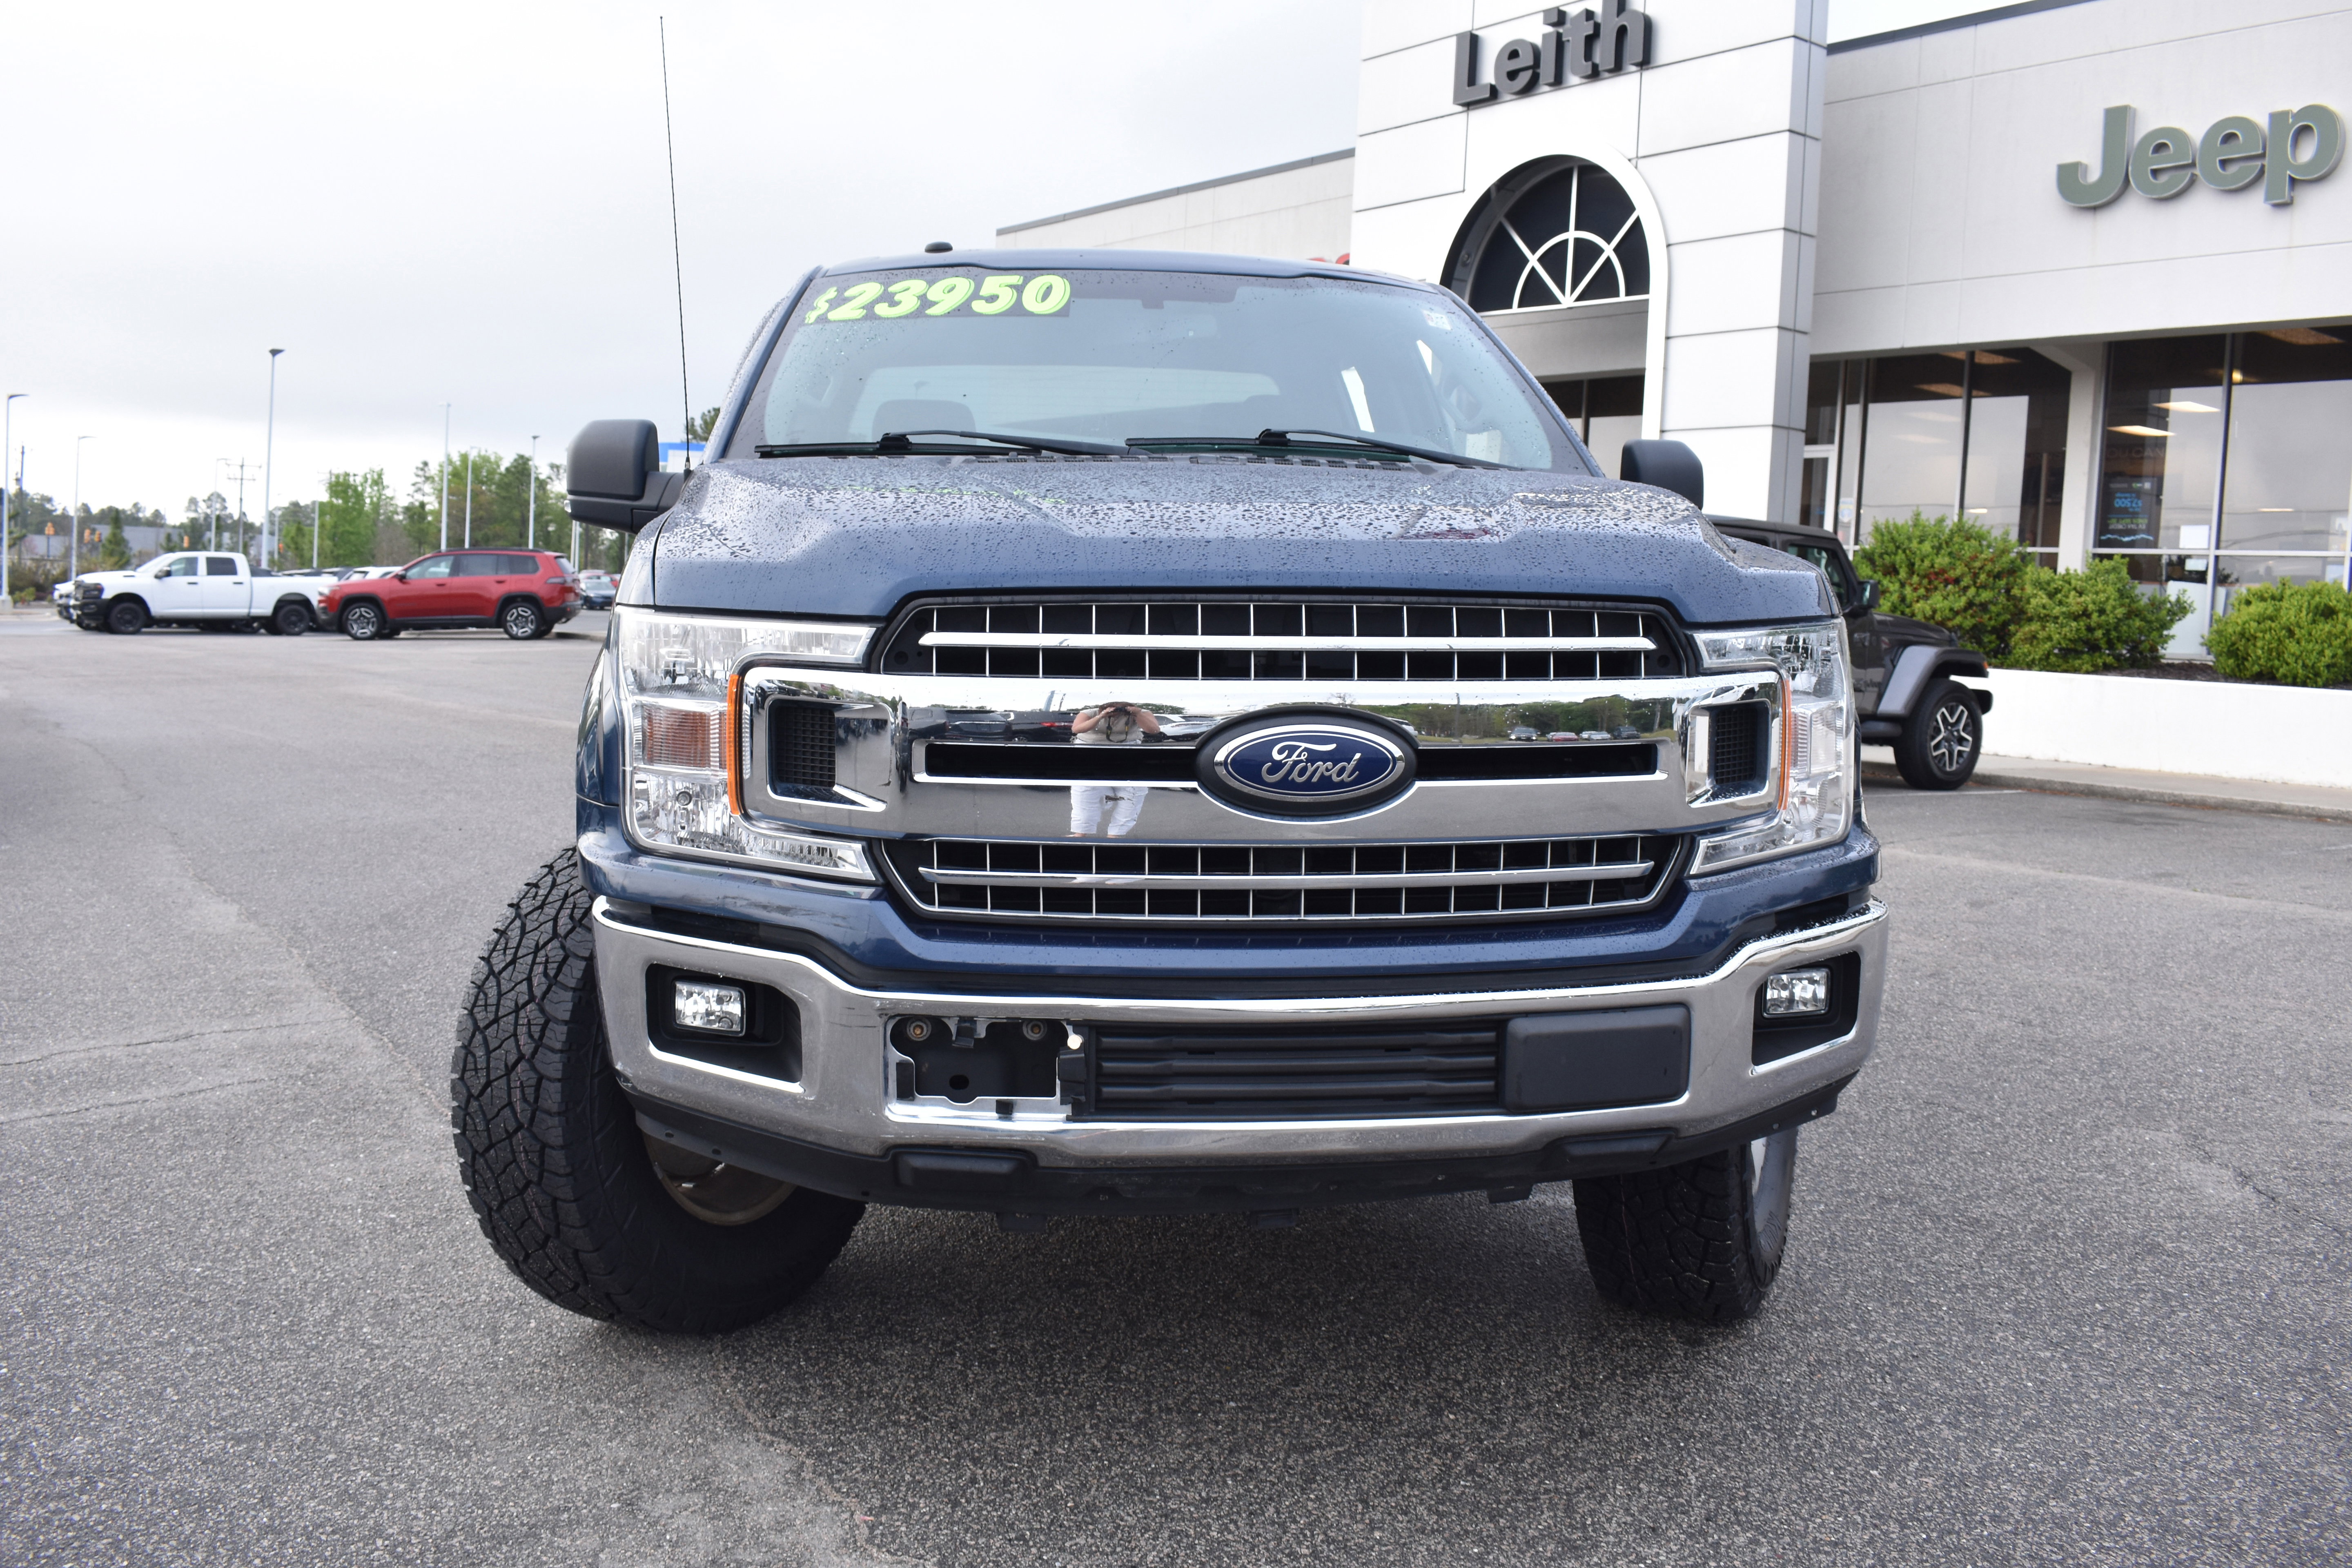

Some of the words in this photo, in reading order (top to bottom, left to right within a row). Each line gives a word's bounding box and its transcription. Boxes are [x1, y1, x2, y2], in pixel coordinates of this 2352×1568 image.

[1453, 0, 1652, 106] Leith
[2057, 104, 2346, 207] Jeep
[805, 275, 1071, 323] $23950
[1261, 741, 1361, 783] Ford
